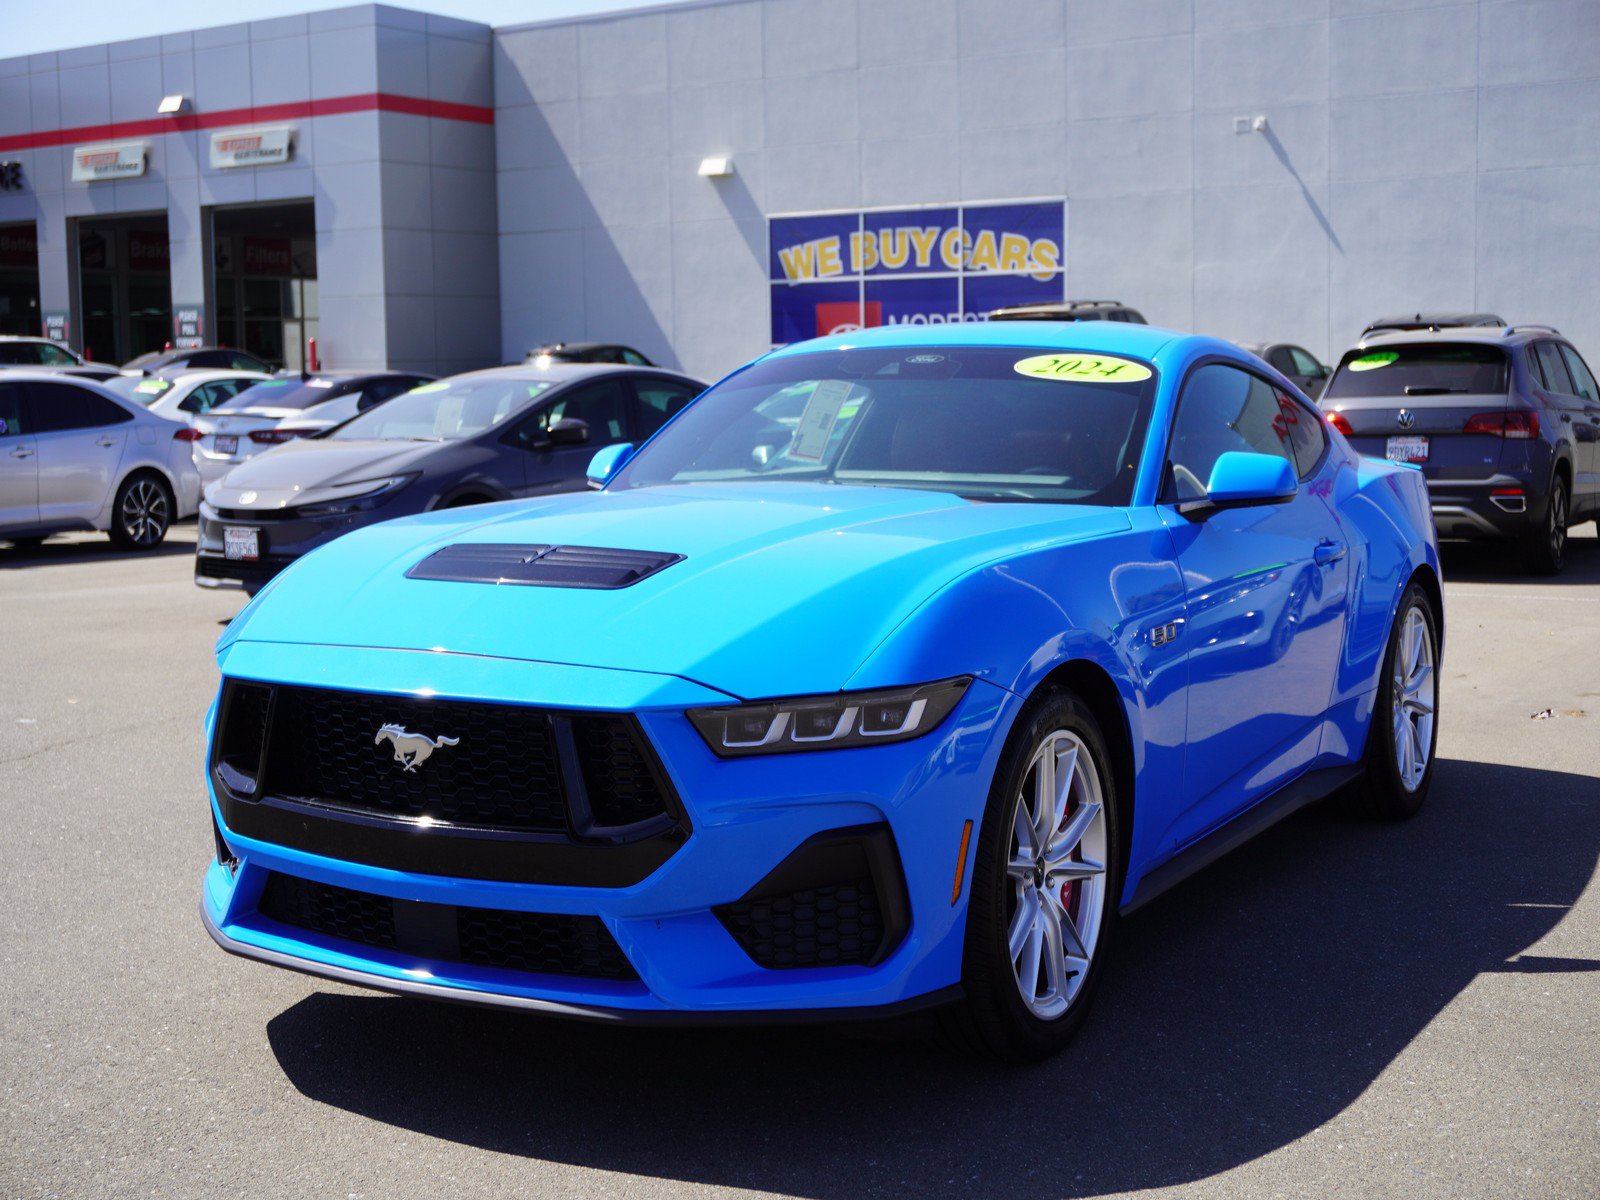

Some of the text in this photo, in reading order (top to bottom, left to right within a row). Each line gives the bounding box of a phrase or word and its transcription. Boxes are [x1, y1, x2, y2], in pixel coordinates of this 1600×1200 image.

[777, 226, 1060, 288] WE BUY CARS
[1033, 359, 1127, 377] 2024
